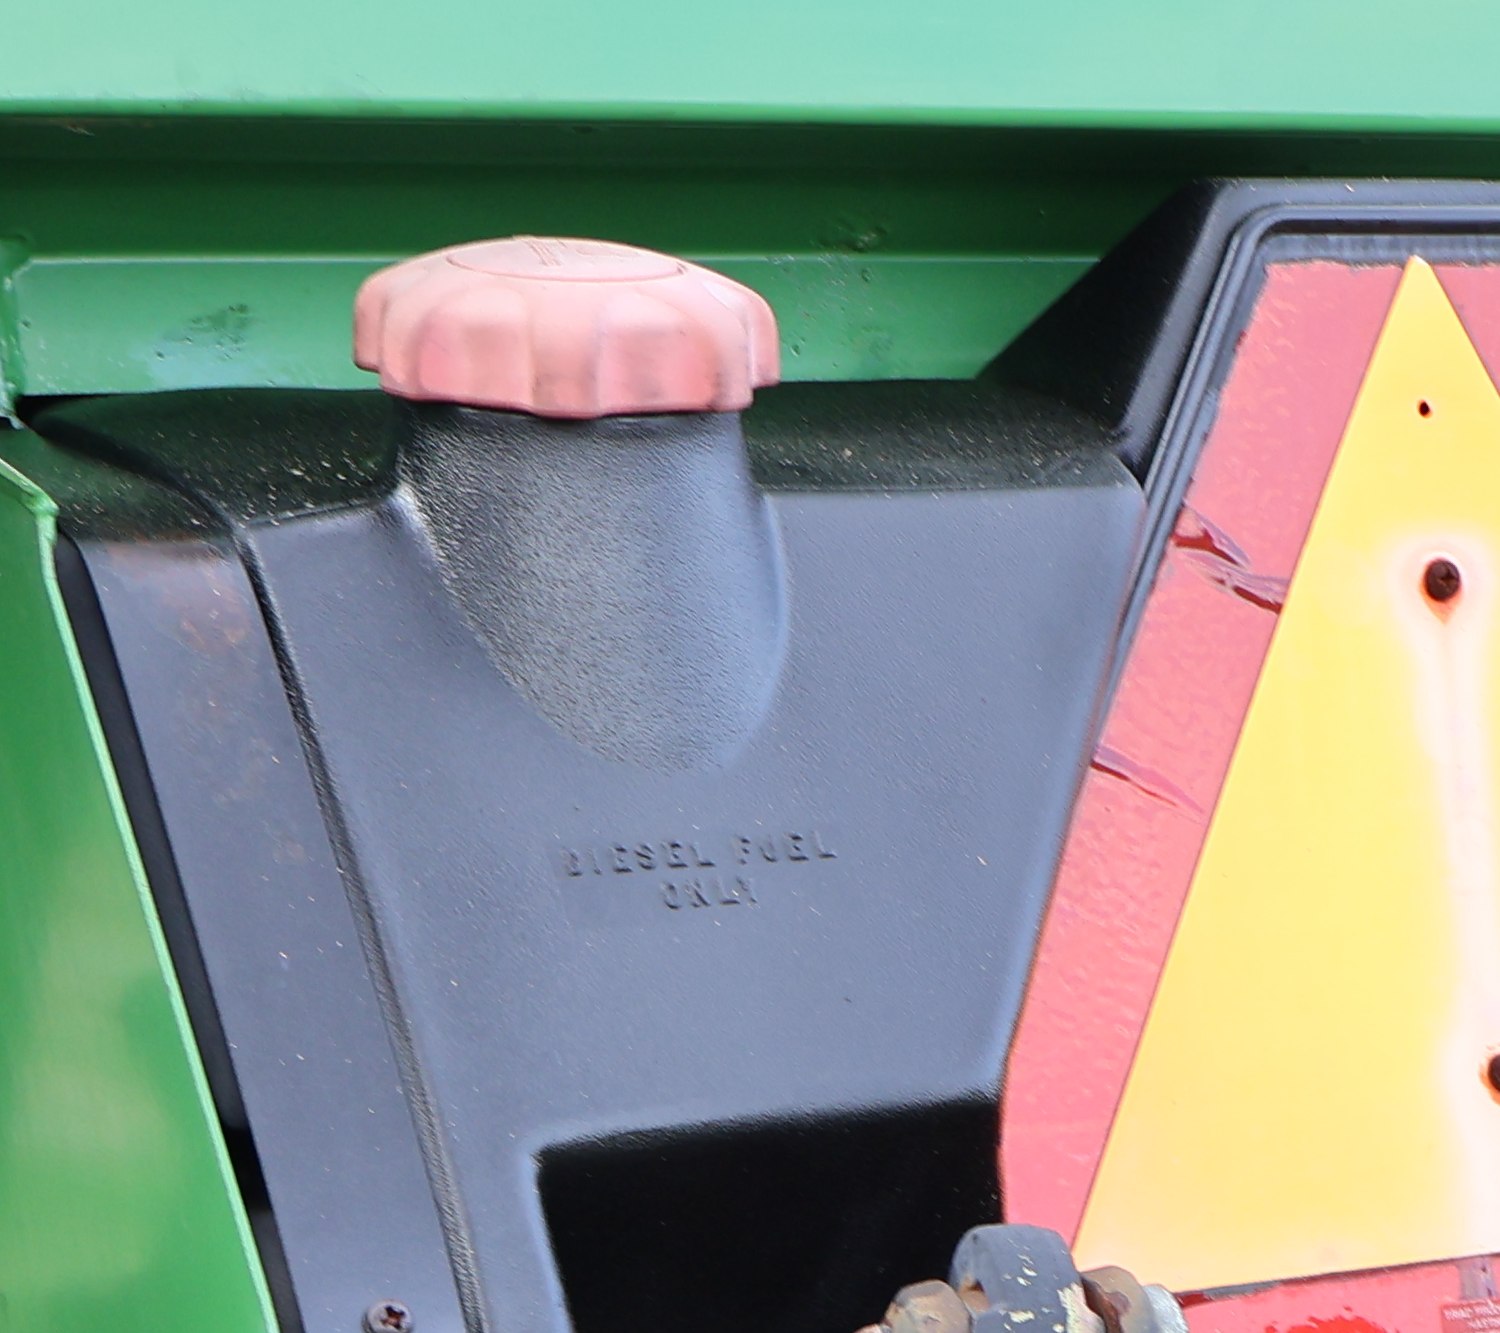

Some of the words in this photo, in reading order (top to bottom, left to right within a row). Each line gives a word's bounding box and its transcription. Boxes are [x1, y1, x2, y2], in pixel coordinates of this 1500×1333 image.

[557, 839, 718, 879] DIESEL
[732, 830, 839, 868] FUEL
[658, 876, 759, 911] ONLY
